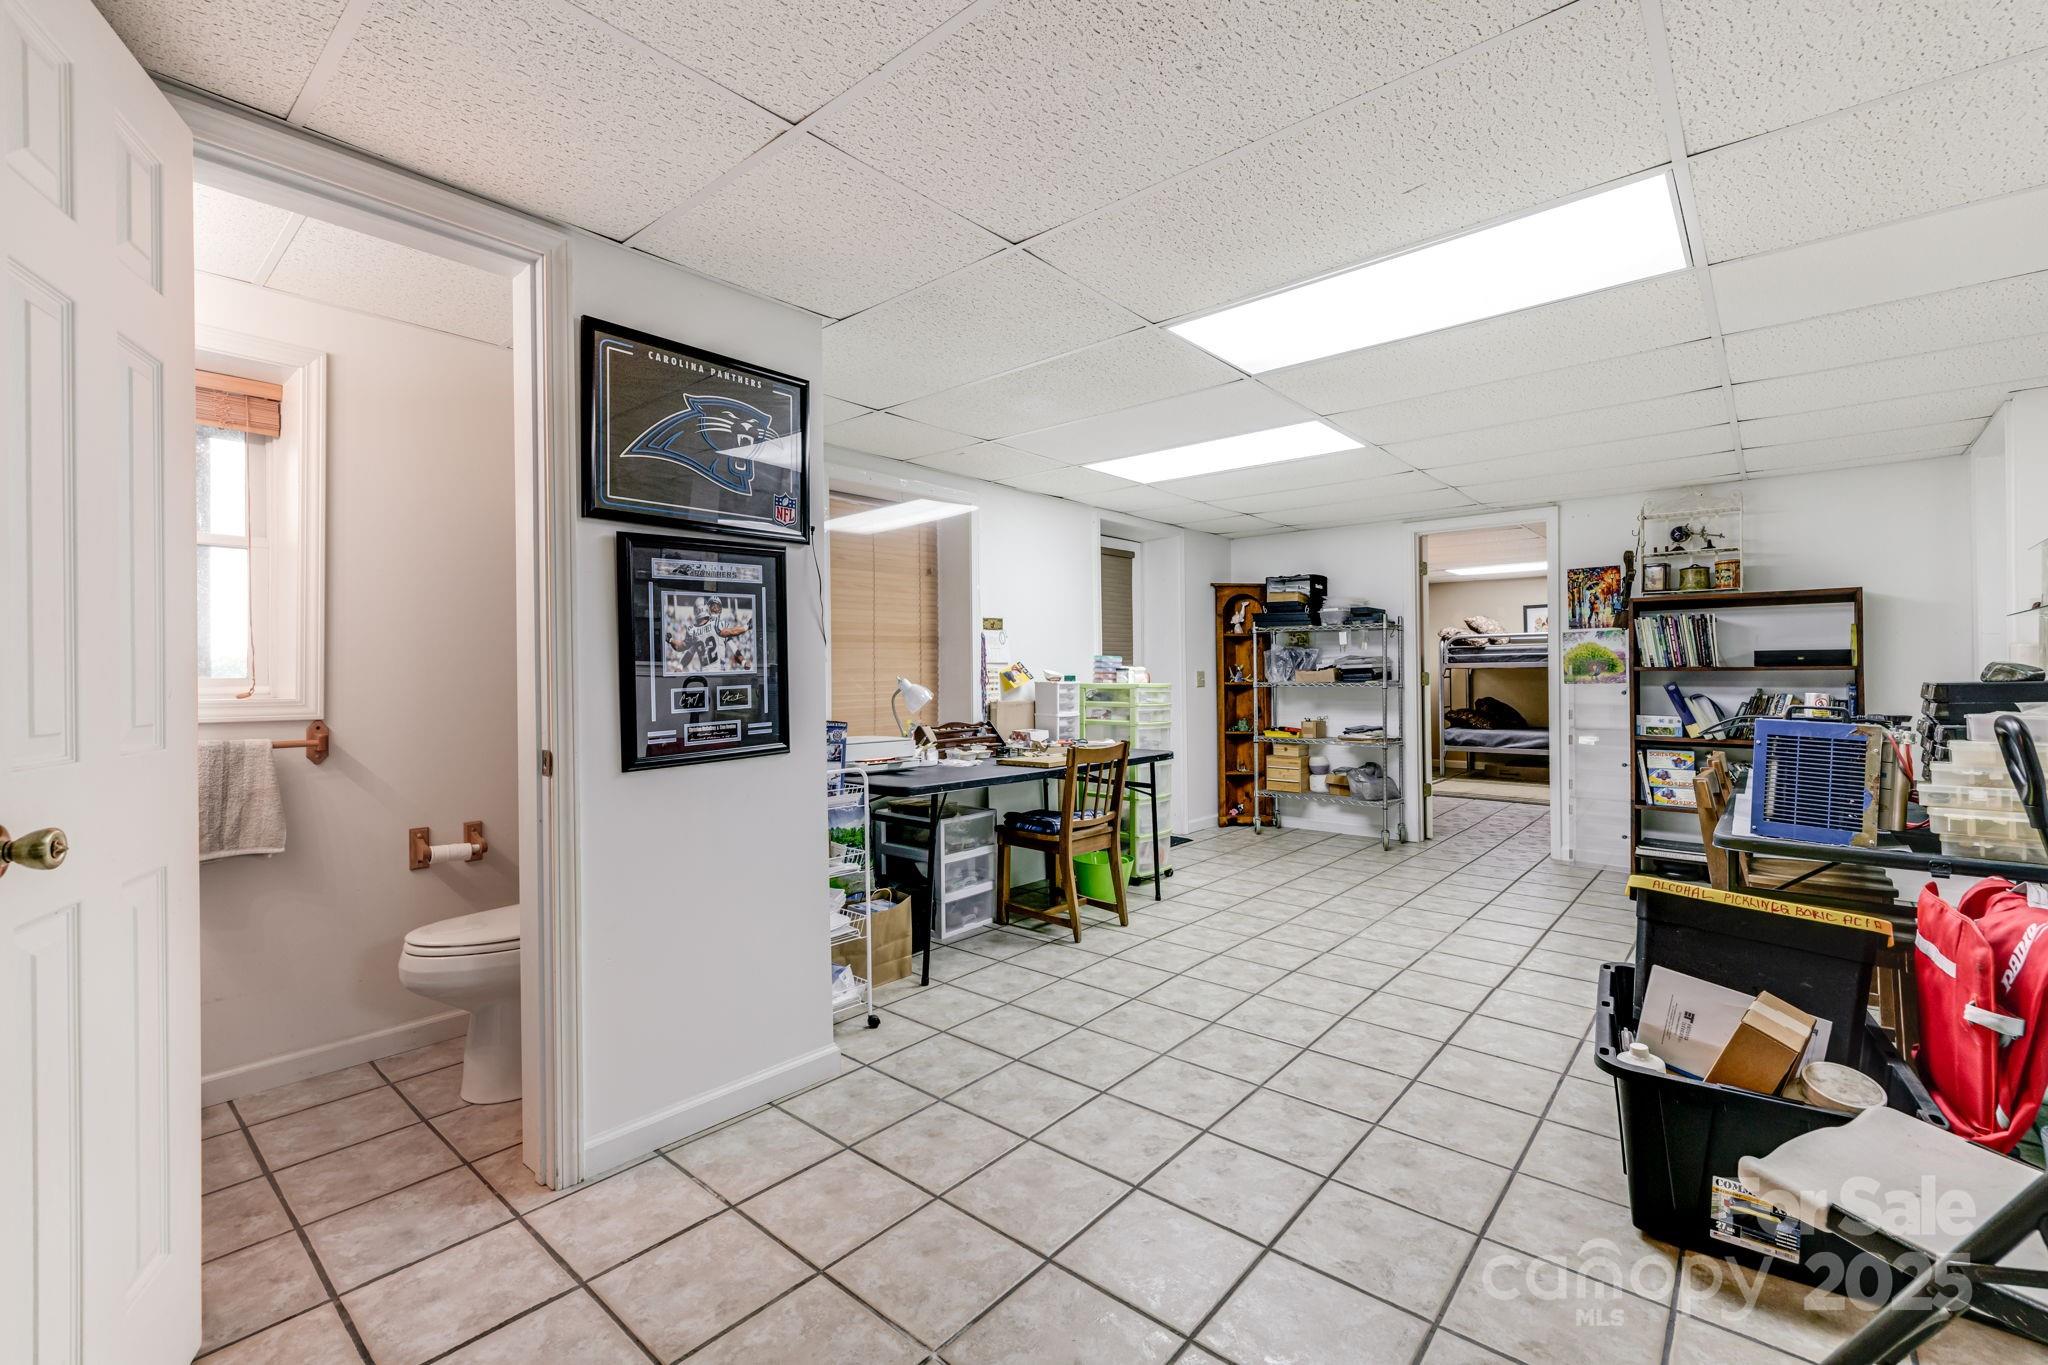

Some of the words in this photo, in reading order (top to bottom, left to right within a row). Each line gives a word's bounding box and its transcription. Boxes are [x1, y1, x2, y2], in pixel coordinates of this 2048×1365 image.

[648, 351, 704, 373] CAROLINA
[710, 367, 762, 389] PANTHERS
[776, 506, 795, 522] NFL
[1715, 1220, 1726, 1231] 27
